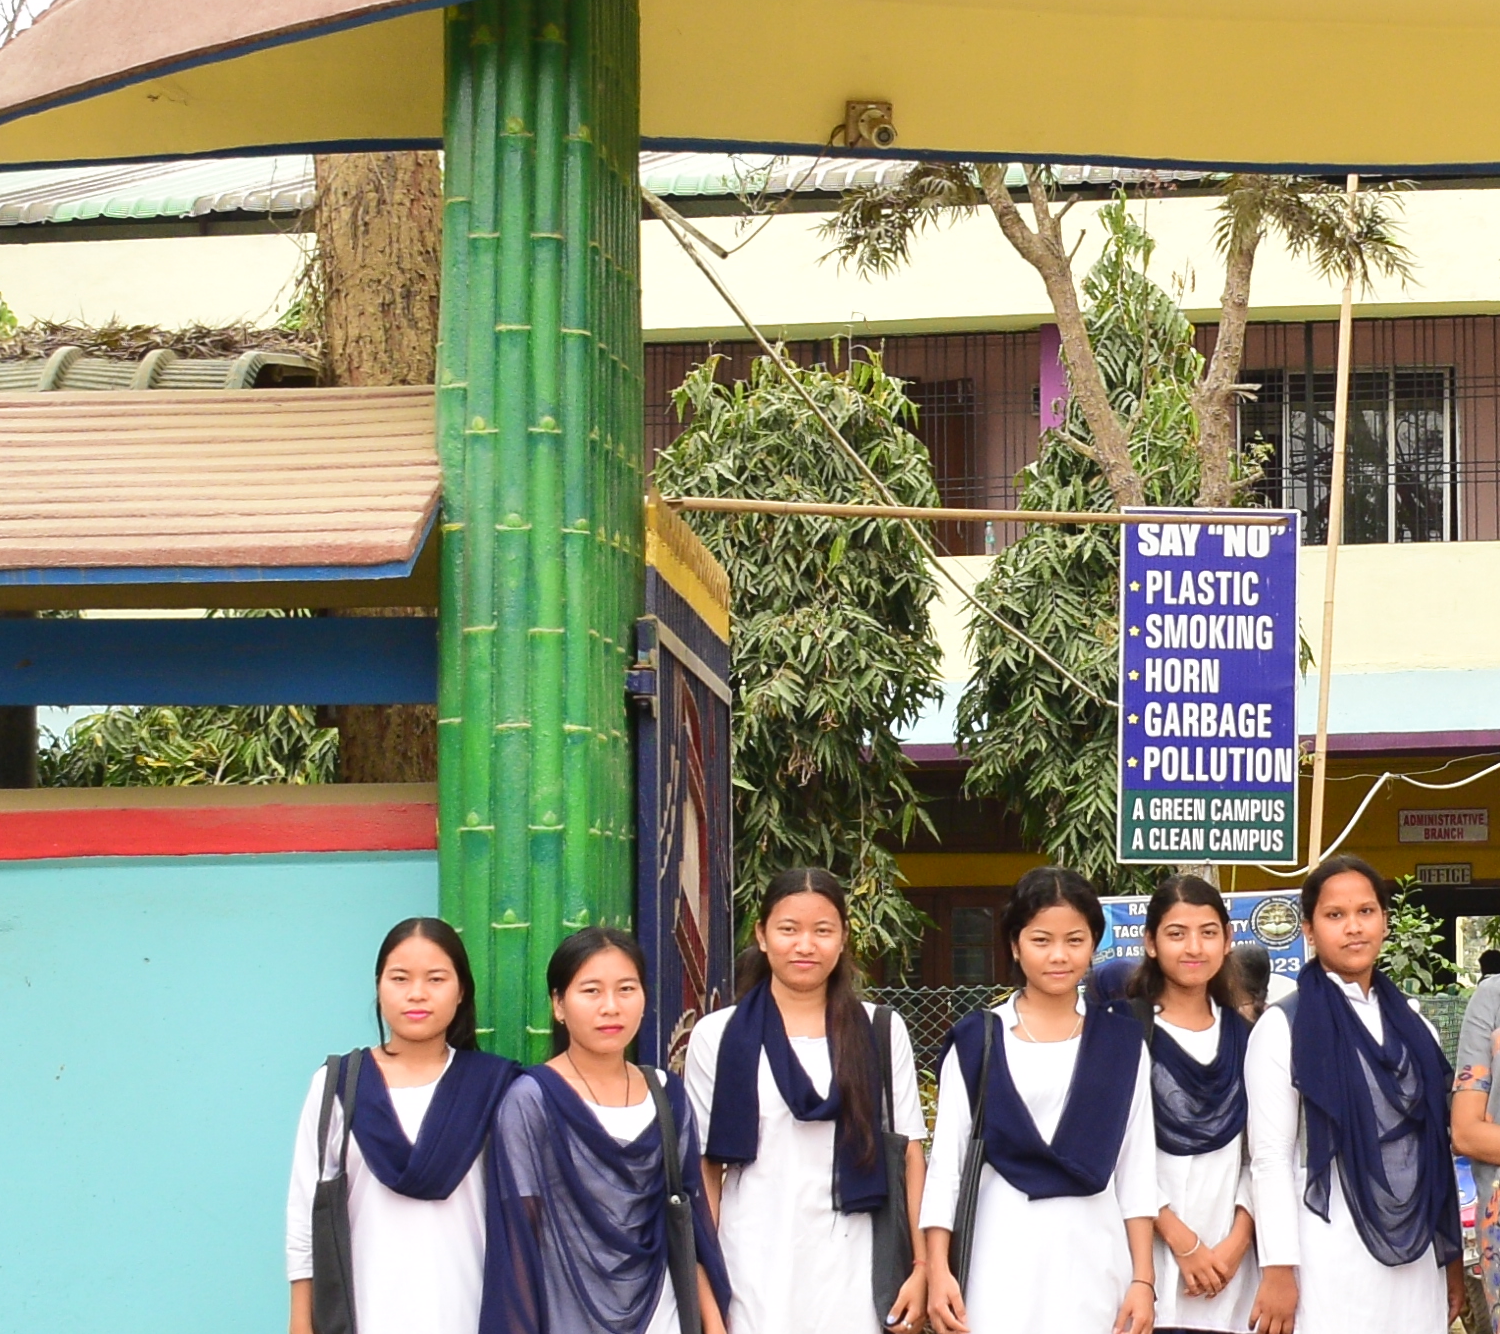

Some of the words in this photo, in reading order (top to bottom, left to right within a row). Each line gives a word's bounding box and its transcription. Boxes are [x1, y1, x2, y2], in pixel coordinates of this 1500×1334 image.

[1138, 524, 1199, 557] SAY
[1146, 570, 1259, 606] PLASTIC
[1145, 614, 1273, 650] SMOKING
[1145, 658, 1220, 694] HORN
[1144, 703, 1272, 738] GARBAGE
[1143, 747, 1292, 783] POLLUTION
[1132, 798, 1145, 821] A
[1149, 798, 1205, 822] GREEN
[1211, 797, 1285, 822] CAMPUS
[1403, 813, 1484, 827] ADMINISTRATIVE
[1132, 828, 1144, 851] A
[1149, 827, 1204, 852] CLEAN
[1209, 827, 1284, 852] CAMPUS
[1423, 827, 1464, 840] BRANCH
[1420, 868, 1470, 884] OFFICE
